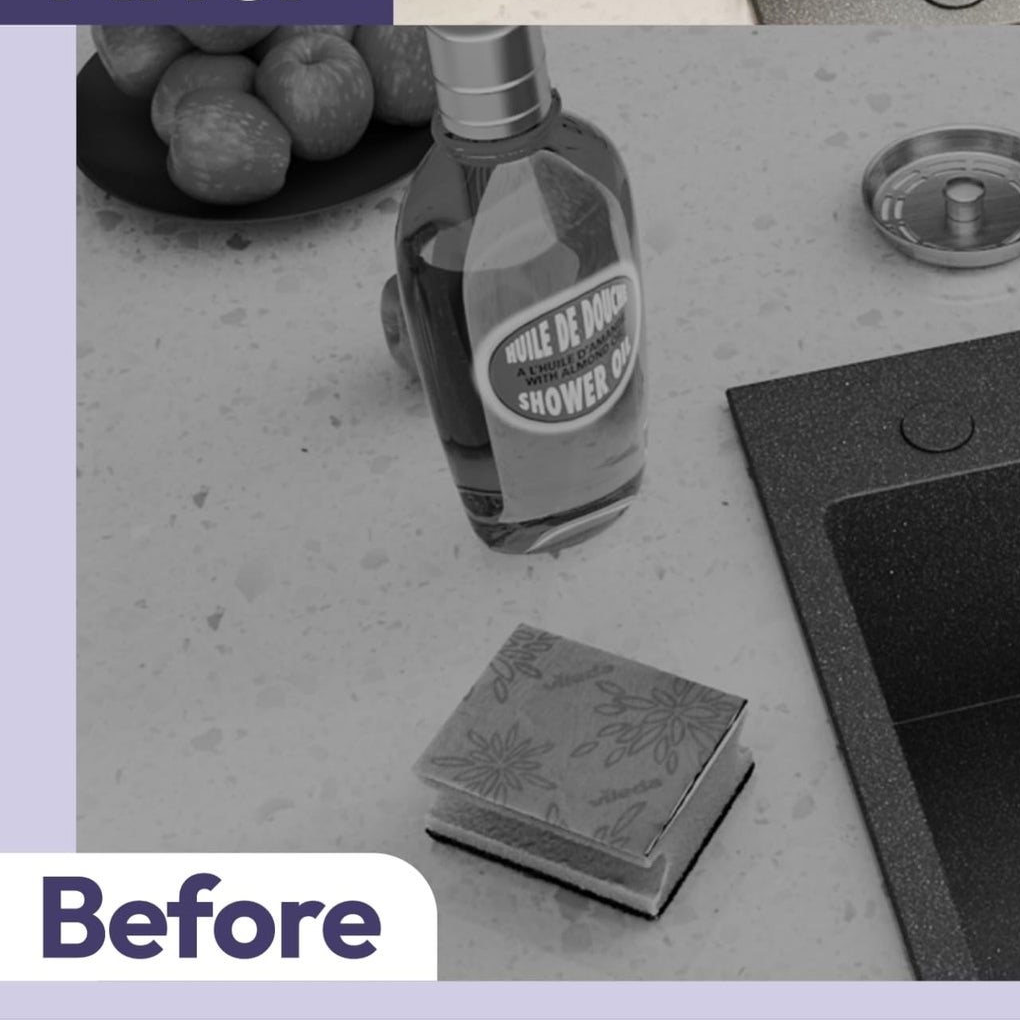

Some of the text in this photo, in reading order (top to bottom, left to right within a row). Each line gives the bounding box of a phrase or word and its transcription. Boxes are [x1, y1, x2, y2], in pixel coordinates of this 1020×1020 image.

[505, 320, 553, 364] HUILE
[554, 306, 581, 353] DE
[516, 368, 526, 378] A
[529, 353, 573, 376] L'HUILE
[518, 336, 631, 416] SHOWER OIL
[525, 344, 609, 387] WITH ALMOND
